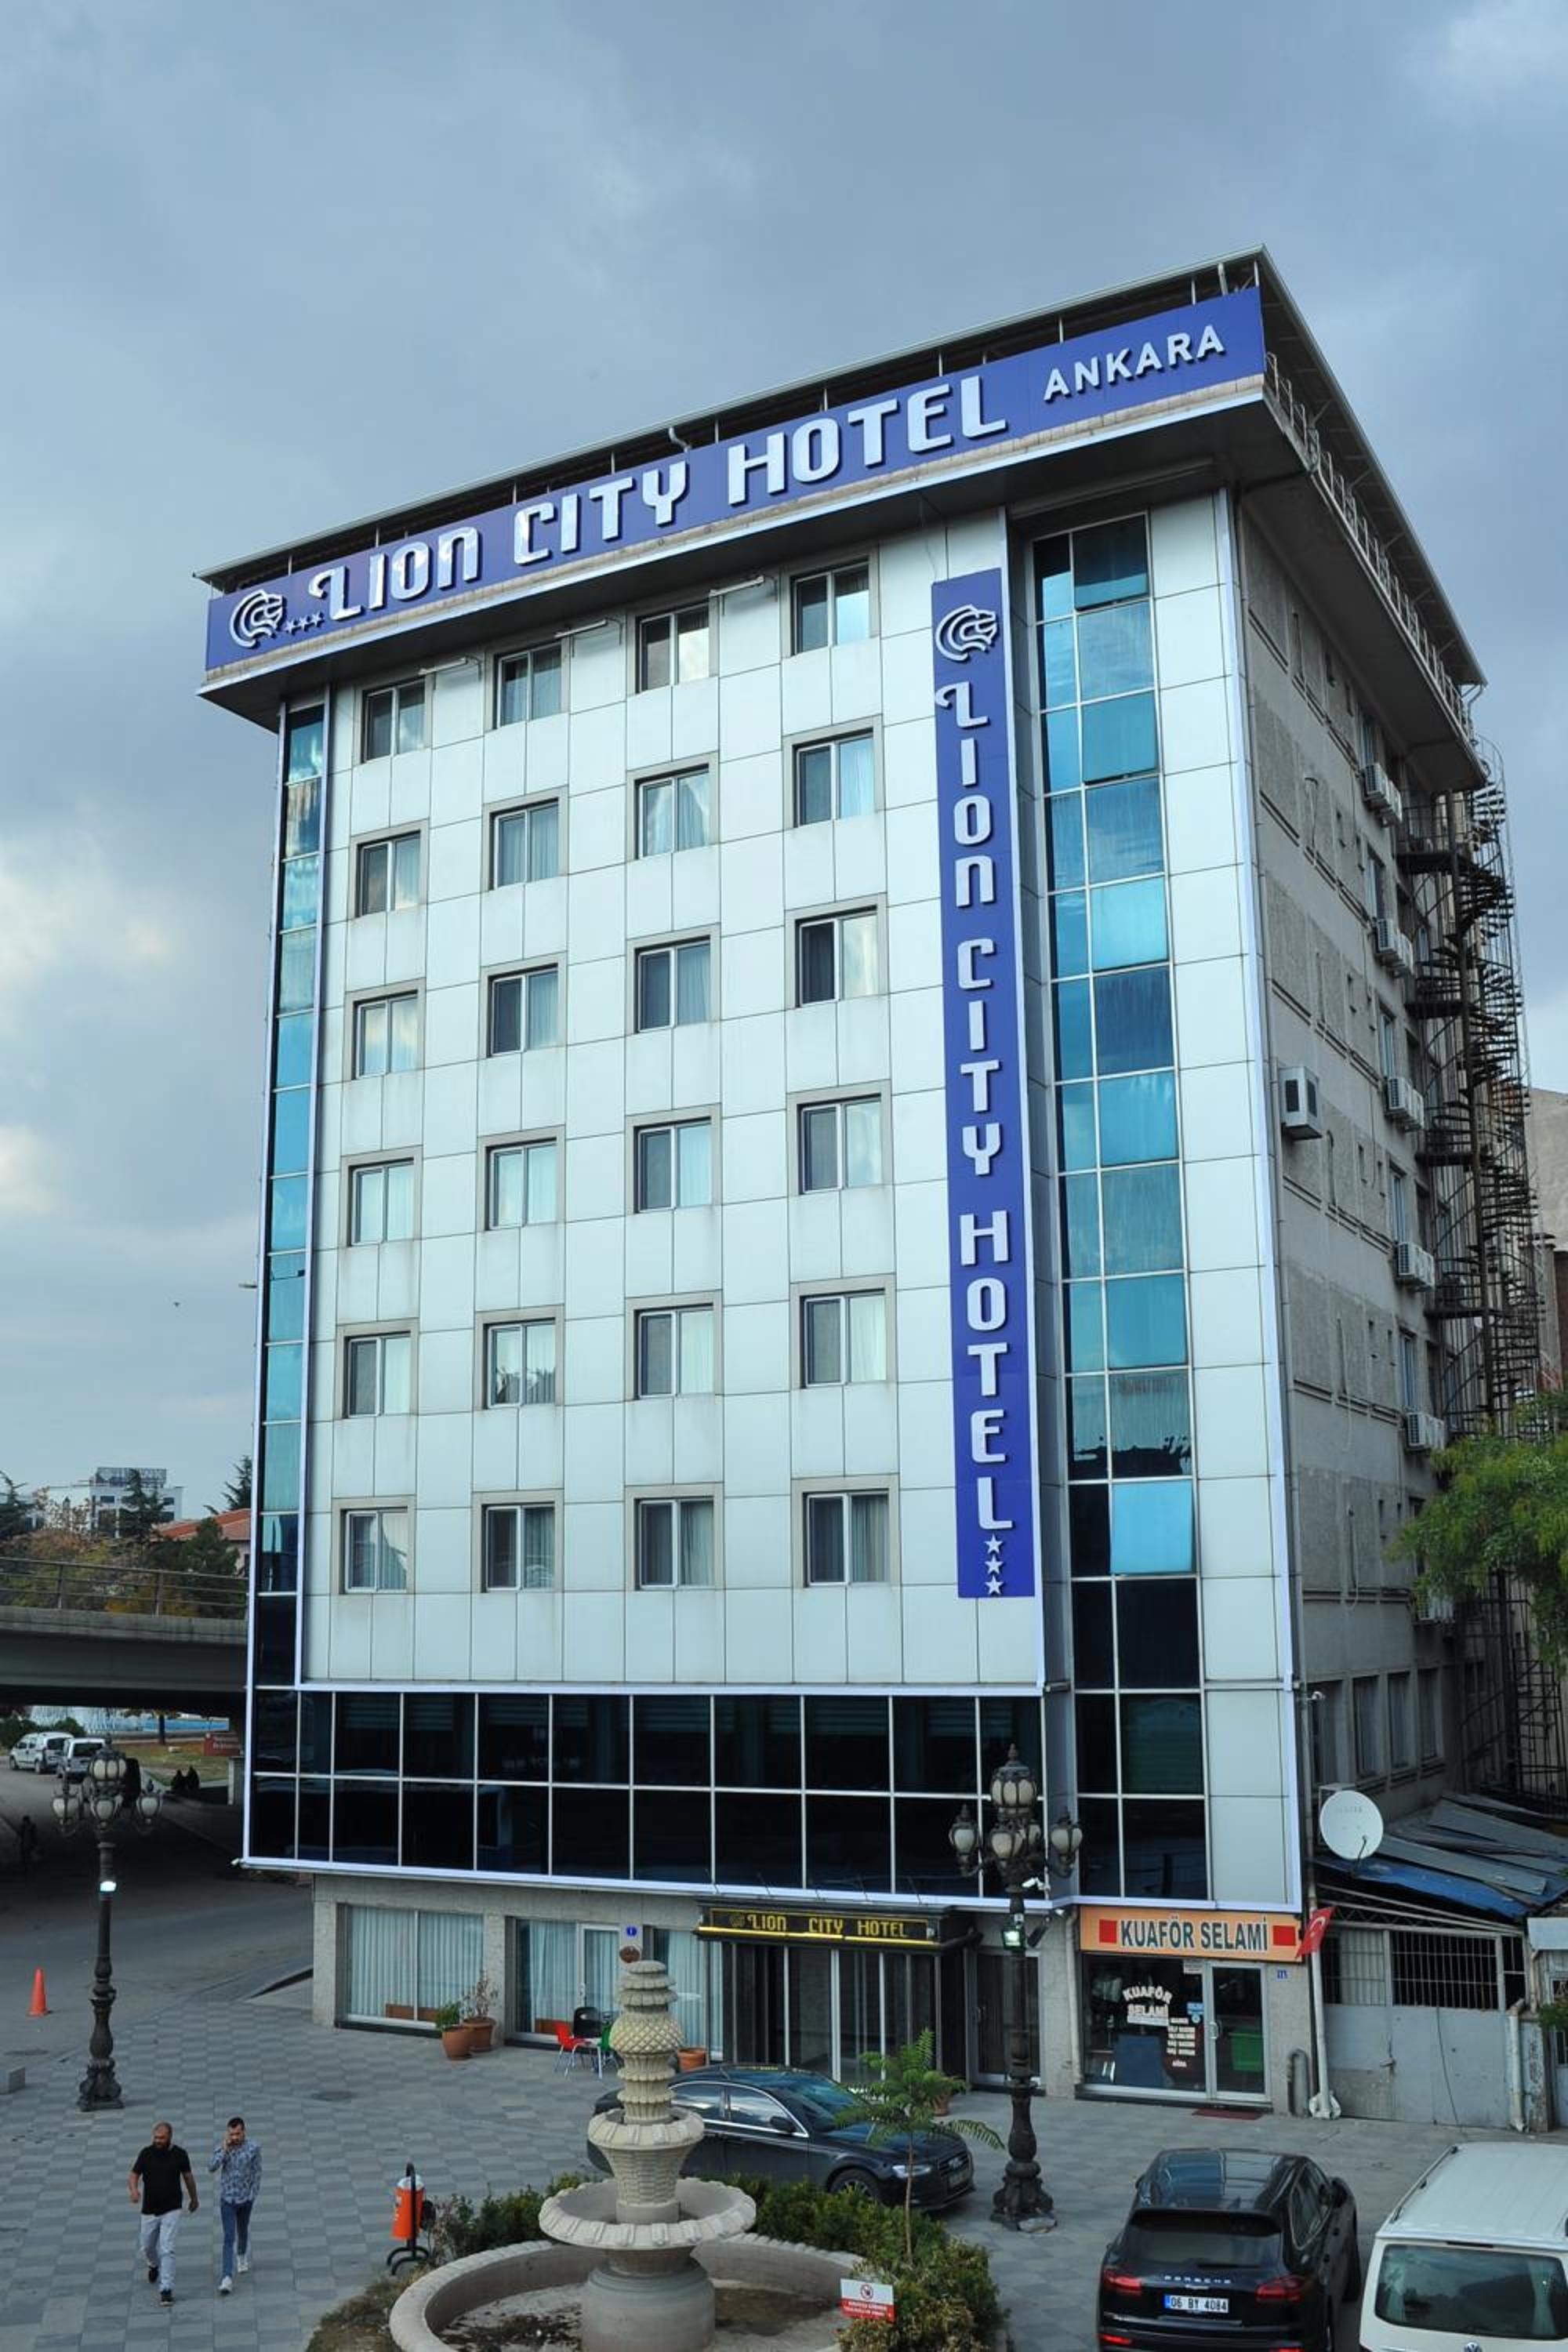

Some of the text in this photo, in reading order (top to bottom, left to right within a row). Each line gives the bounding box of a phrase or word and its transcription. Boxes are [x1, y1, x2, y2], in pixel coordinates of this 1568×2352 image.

[514, 459, 689, 565] CITY
[728, 376, 1007, 506] HOTEL
[1043, 324, 1225, 402] ANKARA
[956, 936, 1003, 1176] CITY
[960, 1209, 1015, 1530] HOTEL
[808, 1917, 845, 1935] CITY
[858, 1920, 908, 1938] HOTEL
[1120, 1915, 1268, 1951] KUAFÖR SELAMİ
[1122, 1985, 1173, 2005] KUAFÖR
[1171, 2296, 1227, 2310] 06 BY 4084
